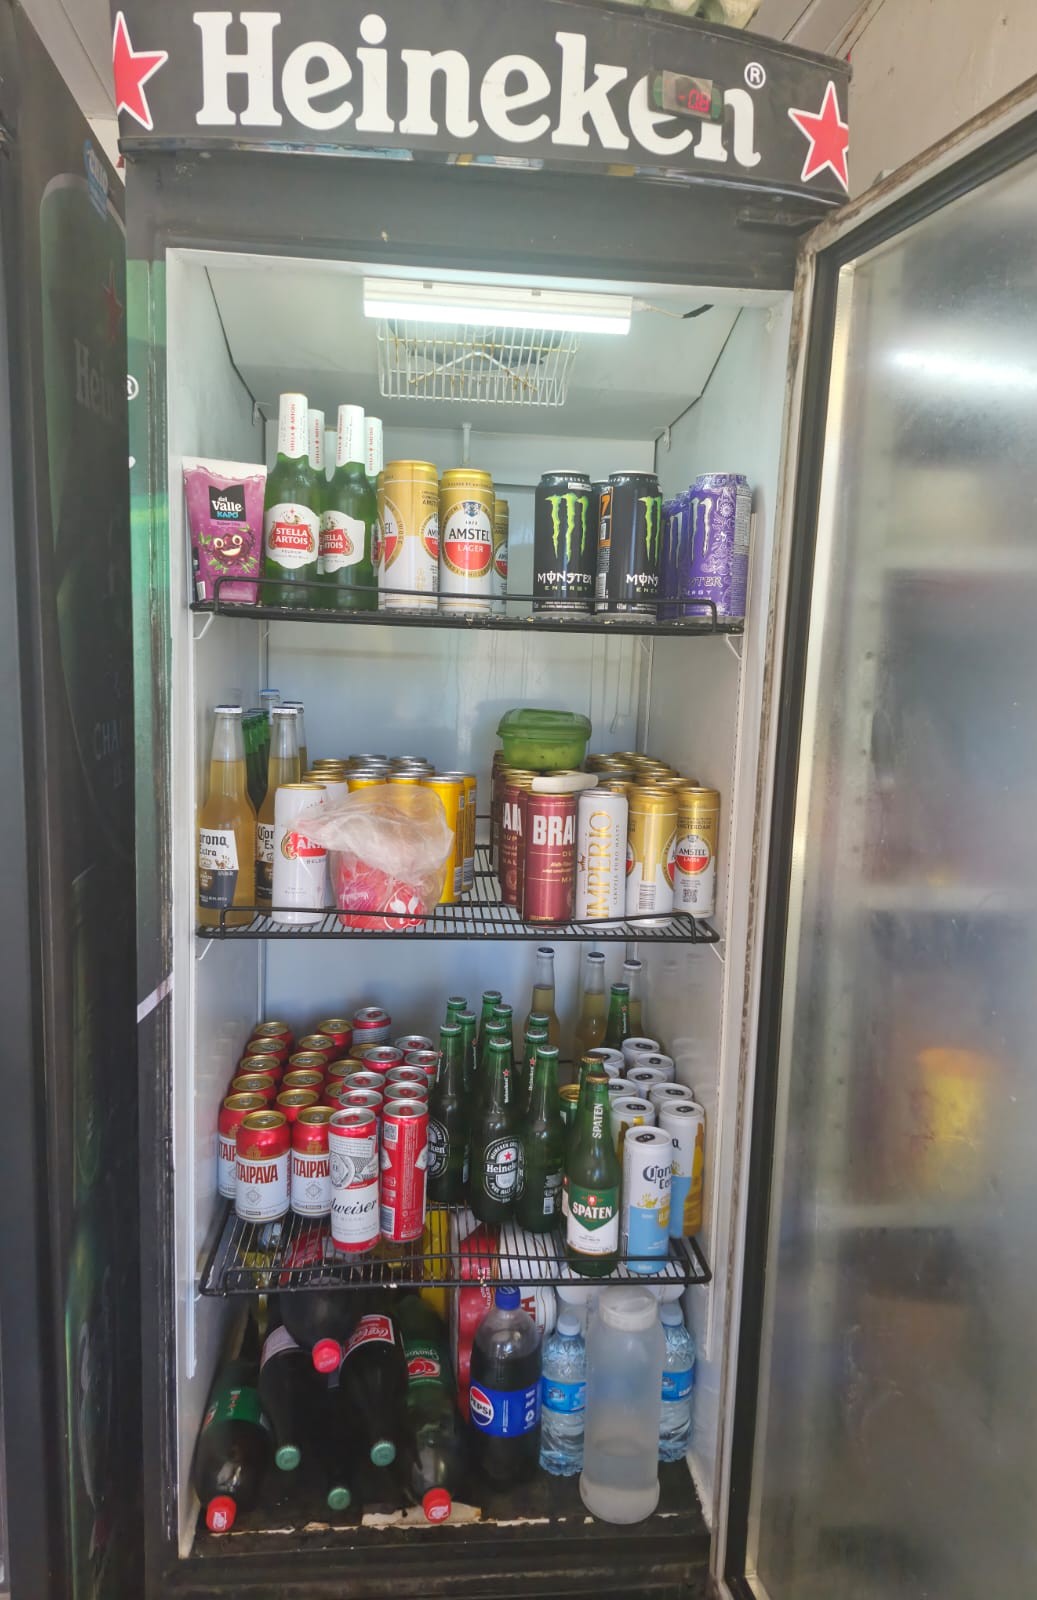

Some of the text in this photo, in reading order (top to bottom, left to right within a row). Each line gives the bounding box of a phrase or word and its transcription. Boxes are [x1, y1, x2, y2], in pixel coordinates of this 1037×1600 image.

[193, 11, 762, 168] Heineken
[211, 500, 242, 512] Valle
[275, 527, 308, 537] STELLA
[448, 528, 490, 542] AMSTEL
[275, 535, 308, 545] ARTOIS
[324, 541, 344, 550] TOIS
[457, 544, 484, 553] LAGER
[537, 570, 592, 584] MONSTER
[258, 826, 273, 842] Cor
[533, 814, 576, 846] BRA
[586, 811, 613, 918] IMPERIO
[592, 1103, 603, 1139] SPATEN
[293, 1157, 330, 1179] ITAIPAV
[572, 1201, 613, 1219] SPATEN
